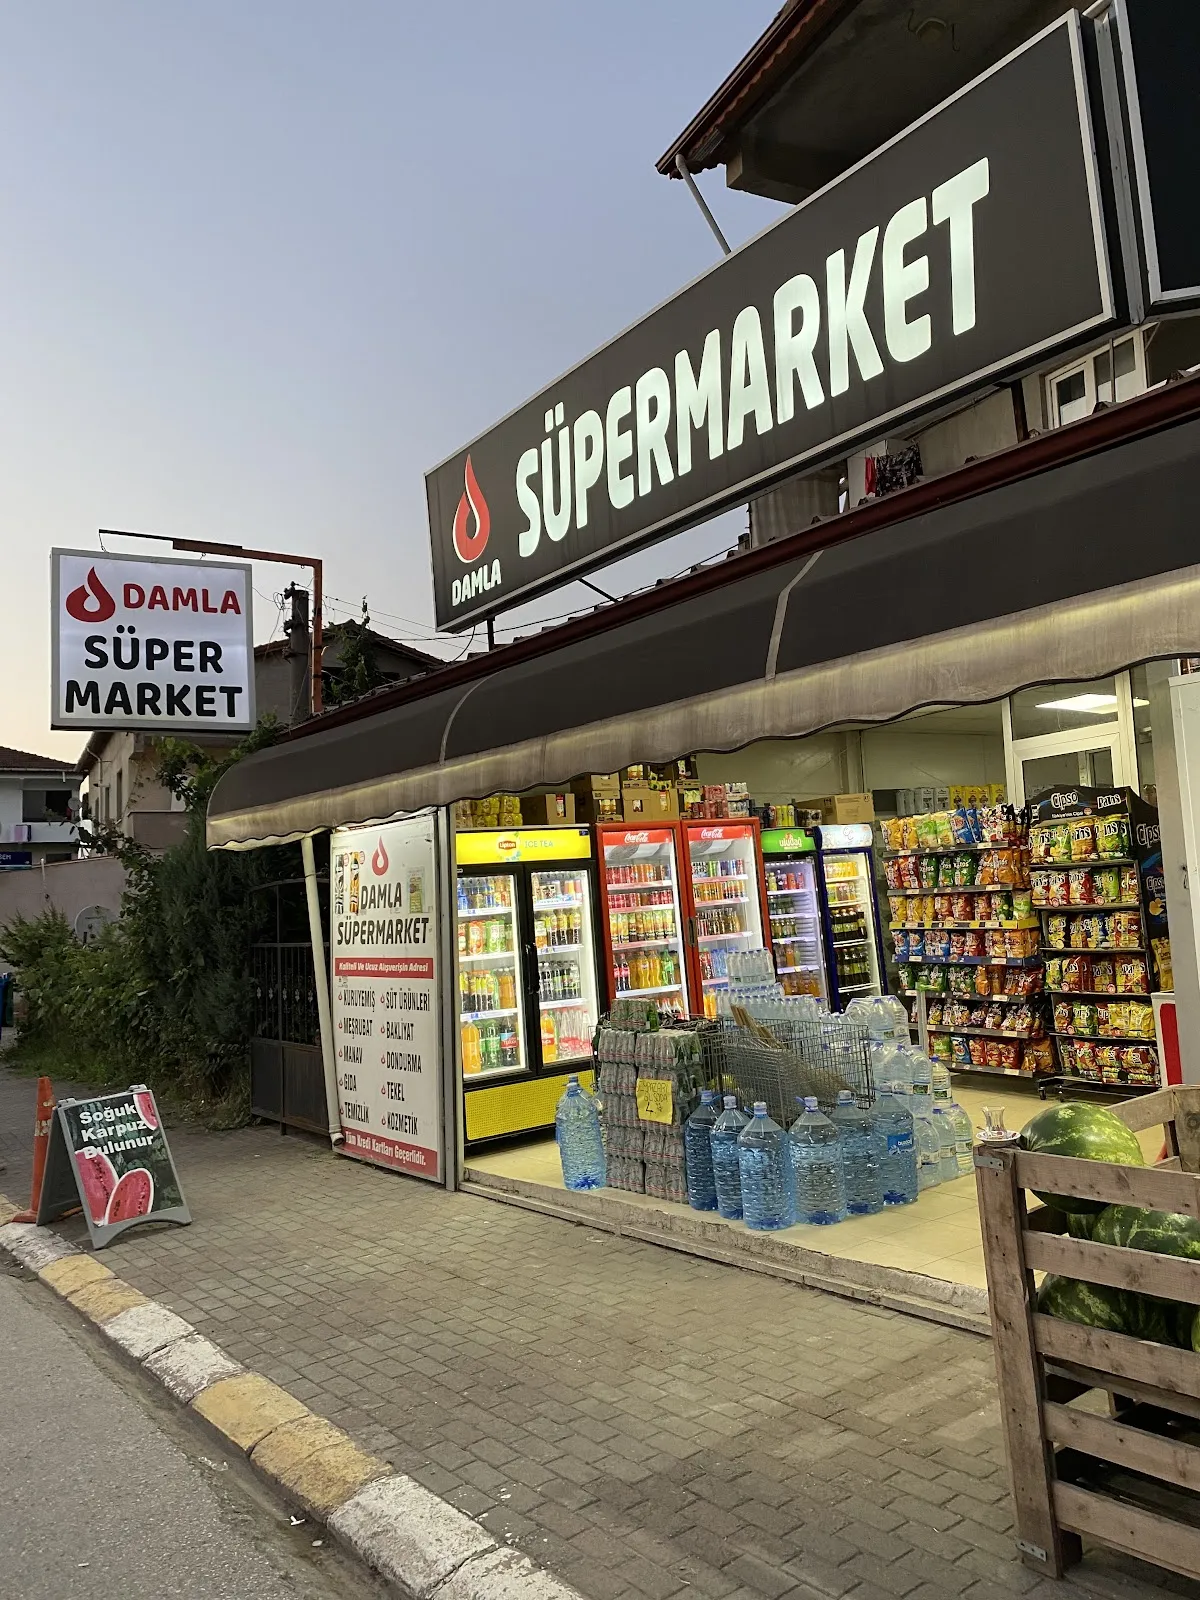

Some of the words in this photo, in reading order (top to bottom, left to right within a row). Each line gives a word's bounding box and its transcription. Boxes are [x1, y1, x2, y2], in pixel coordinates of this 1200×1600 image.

[516, 157, 990, 558] SÜPERMARKET
[452, 558, 502, 607] DAMLA
[123, 583, 241, 615] DAMLA
[84, 624, 224, 674] SÜPER
[65, 679, 243, 718] MARKET
[499, 841, 516, 849] Lipton
[539, 840, 554, 848] TEA
[1136, 823, 1160, 848] Cips
[361, 882, 402, 910] DAMLA
[337, 916, 429, 945] SÜPERMARKET
[339, 962, 357, 971] Kaliteli
[357, 962, 365, 971] Ve
[365, 963, 378, 971] Ucuz
[379, 963, 408, 973] Alışverişin
[409, 963, 428, 972] Adresi
[343, 986, 376, 1013] KURUYEMİŞ
[386, 987, 397, 1009] SÜT
[399, 987, 430, 1011] ÜRÜNLERİ
[343, 1017, 373, 1039] MEŞRUBAT
[386, 1018, 414, 1041] BAKLİYAT
[343, 1045, 363, 1064] MANAV
[386, 1051, 422, 1073] DONDURMA
[344, 1073, 357, 1091] GIDA
[387, 1081, 405, 1102] TEKEL
[79, 1103, 138, 1125] Soğuk
[344, 1100, 370, 1123] TEMİZLİK
[387, 1111, 418, 1135] KOZMETİK
[81, 1120, 148, 1142] Karpuz
[82, 1135, 154, 1160] Bulunur
[345, 1131, 356, 1145] Tüm
[357, 1134, 371, 1149] Kredi
[371, 1138, 394, 1157] Kartları
[394, 1145, 426, 1166] Geçerlidir.
